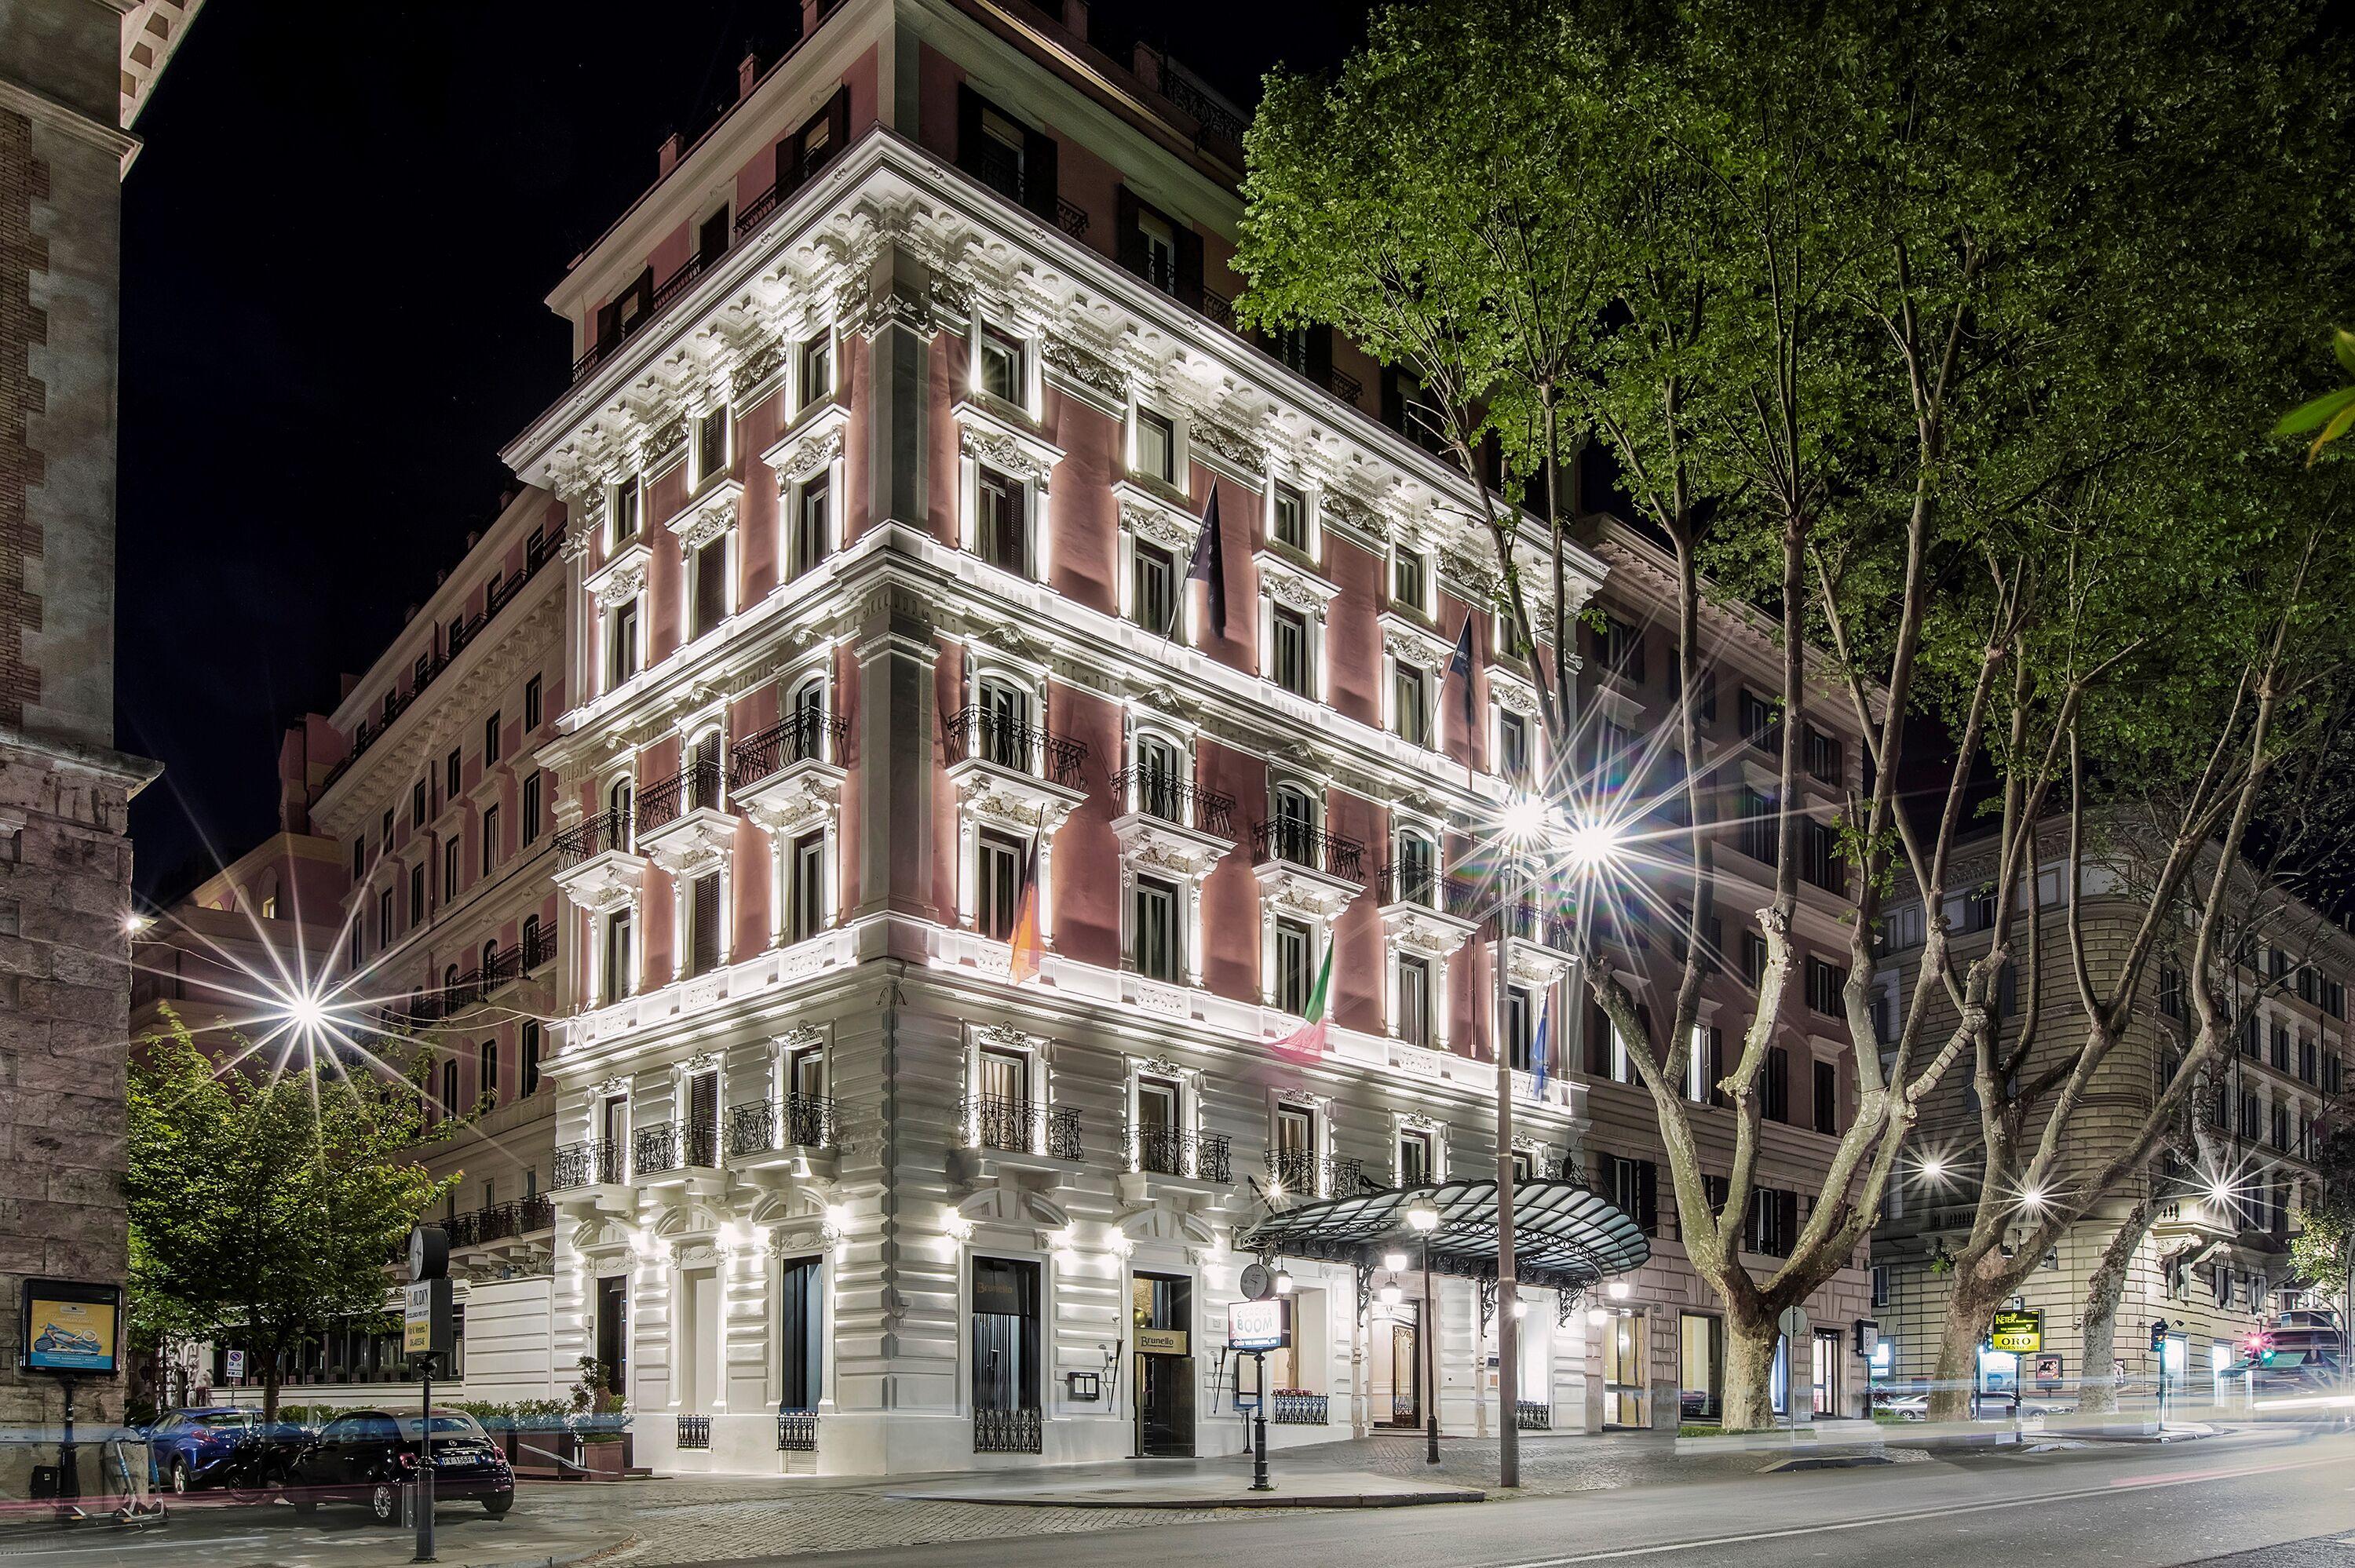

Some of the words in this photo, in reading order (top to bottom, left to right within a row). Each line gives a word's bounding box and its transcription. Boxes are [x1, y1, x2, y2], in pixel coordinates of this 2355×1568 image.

[977, 1281, 1013, 1293] Brunello
[1237, 1316, 1272, 1333] BOOM
[1995, 1315, 2015, 1325] KETER
[1141, 1336, 1174, 1347] Brunello
